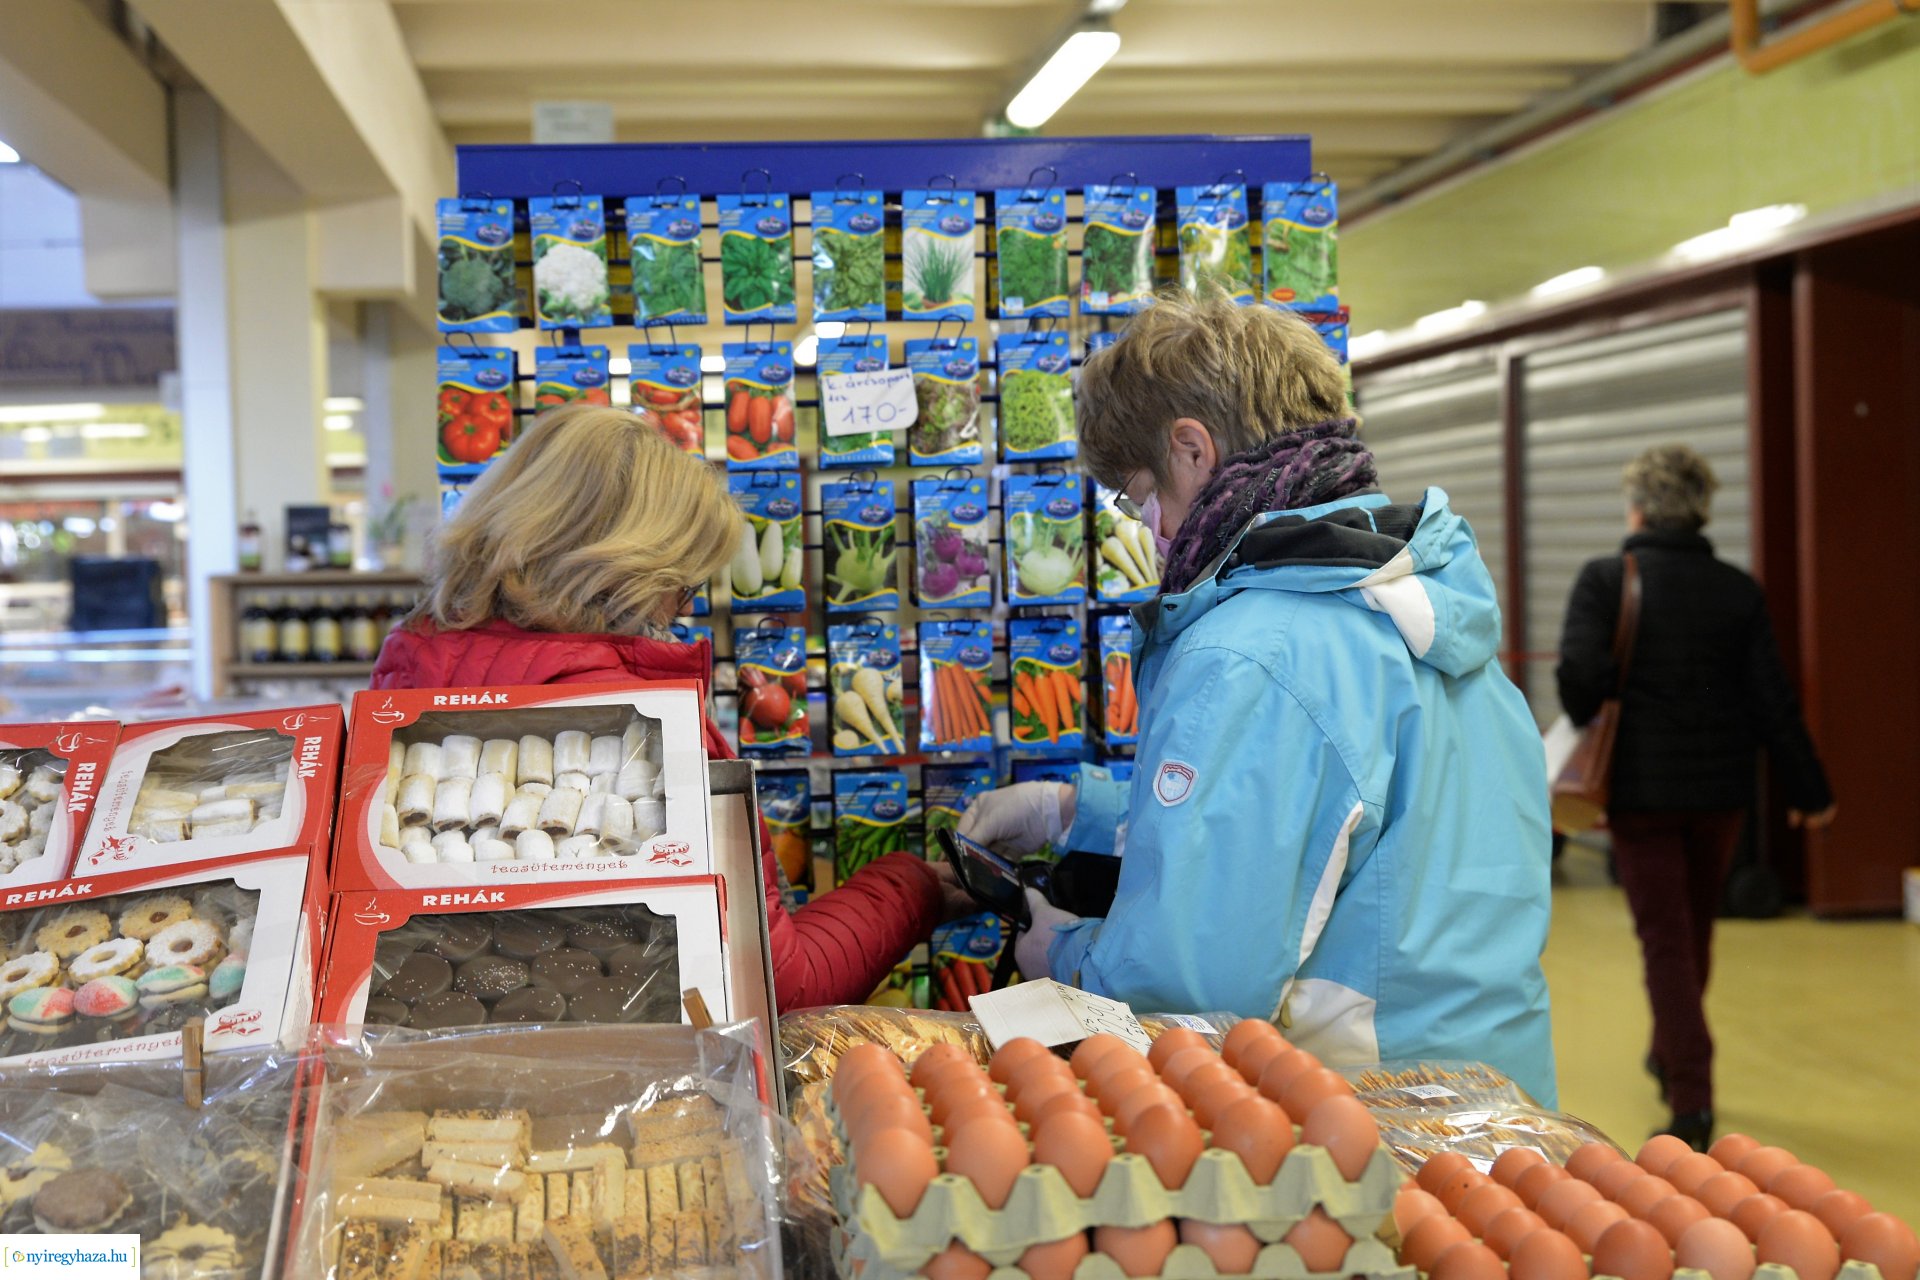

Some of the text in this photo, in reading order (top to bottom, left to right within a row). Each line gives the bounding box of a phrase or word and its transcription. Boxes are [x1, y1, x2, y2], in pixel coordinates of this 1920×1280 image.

[433, 691, 509, 706] REHÁK
[296, 736, 322, 780] REHÁK
[67, 761, 97, 814] REHÁK
[490, 859, 629, 874] teasütemények
[5, 883, 92, 906] REHÁK
[422, 890, 507, 907] REHÁK
